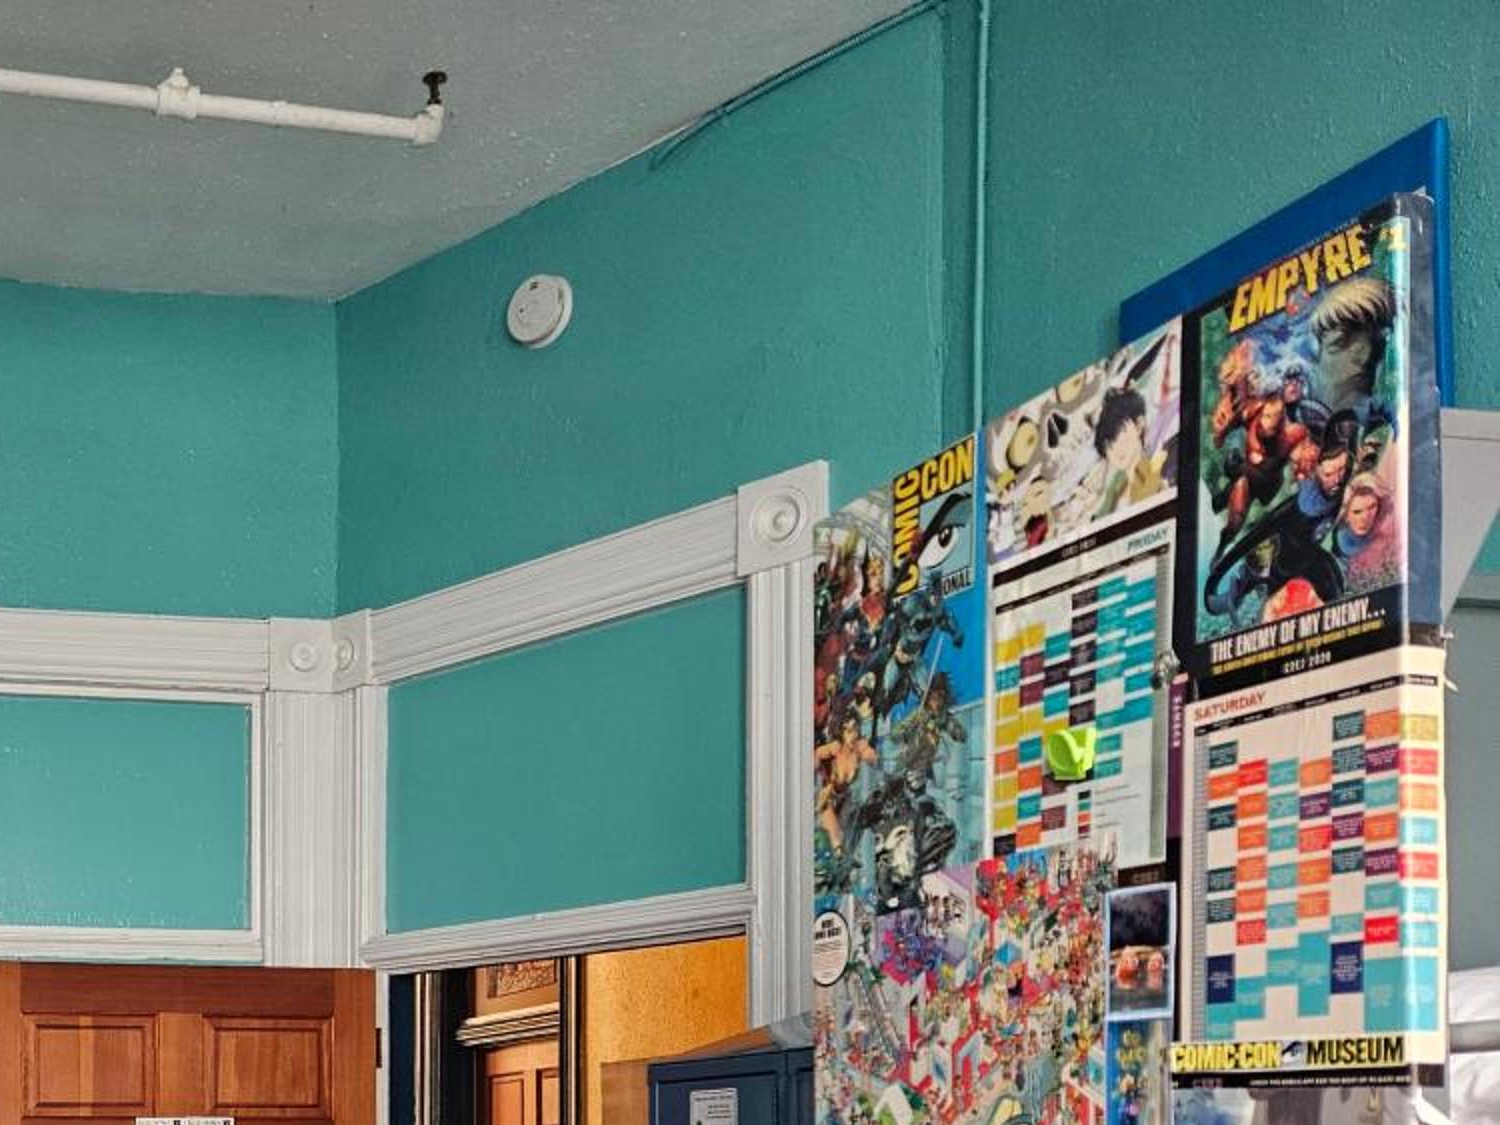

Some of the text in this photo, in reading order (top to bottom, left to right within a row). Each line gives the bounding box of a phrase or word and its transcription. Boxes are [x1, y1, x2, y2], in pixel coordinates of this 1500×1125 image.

[1229, 223, 1372, 334] EMPYRE
[921, 438, 974, 501] CON
[894, 469, 920, 593] COMIC
[1211, 637, 1234, 664] THE
[1236, 623, 1278, 658] ENEMY
[1280, 620, 1296, 646] OF
[1299, 612, 1321, 640] MY
[1193, 691, 1266, 722] SATURDAY
[1306, 1036, 1404, 1065] MUSEUM
